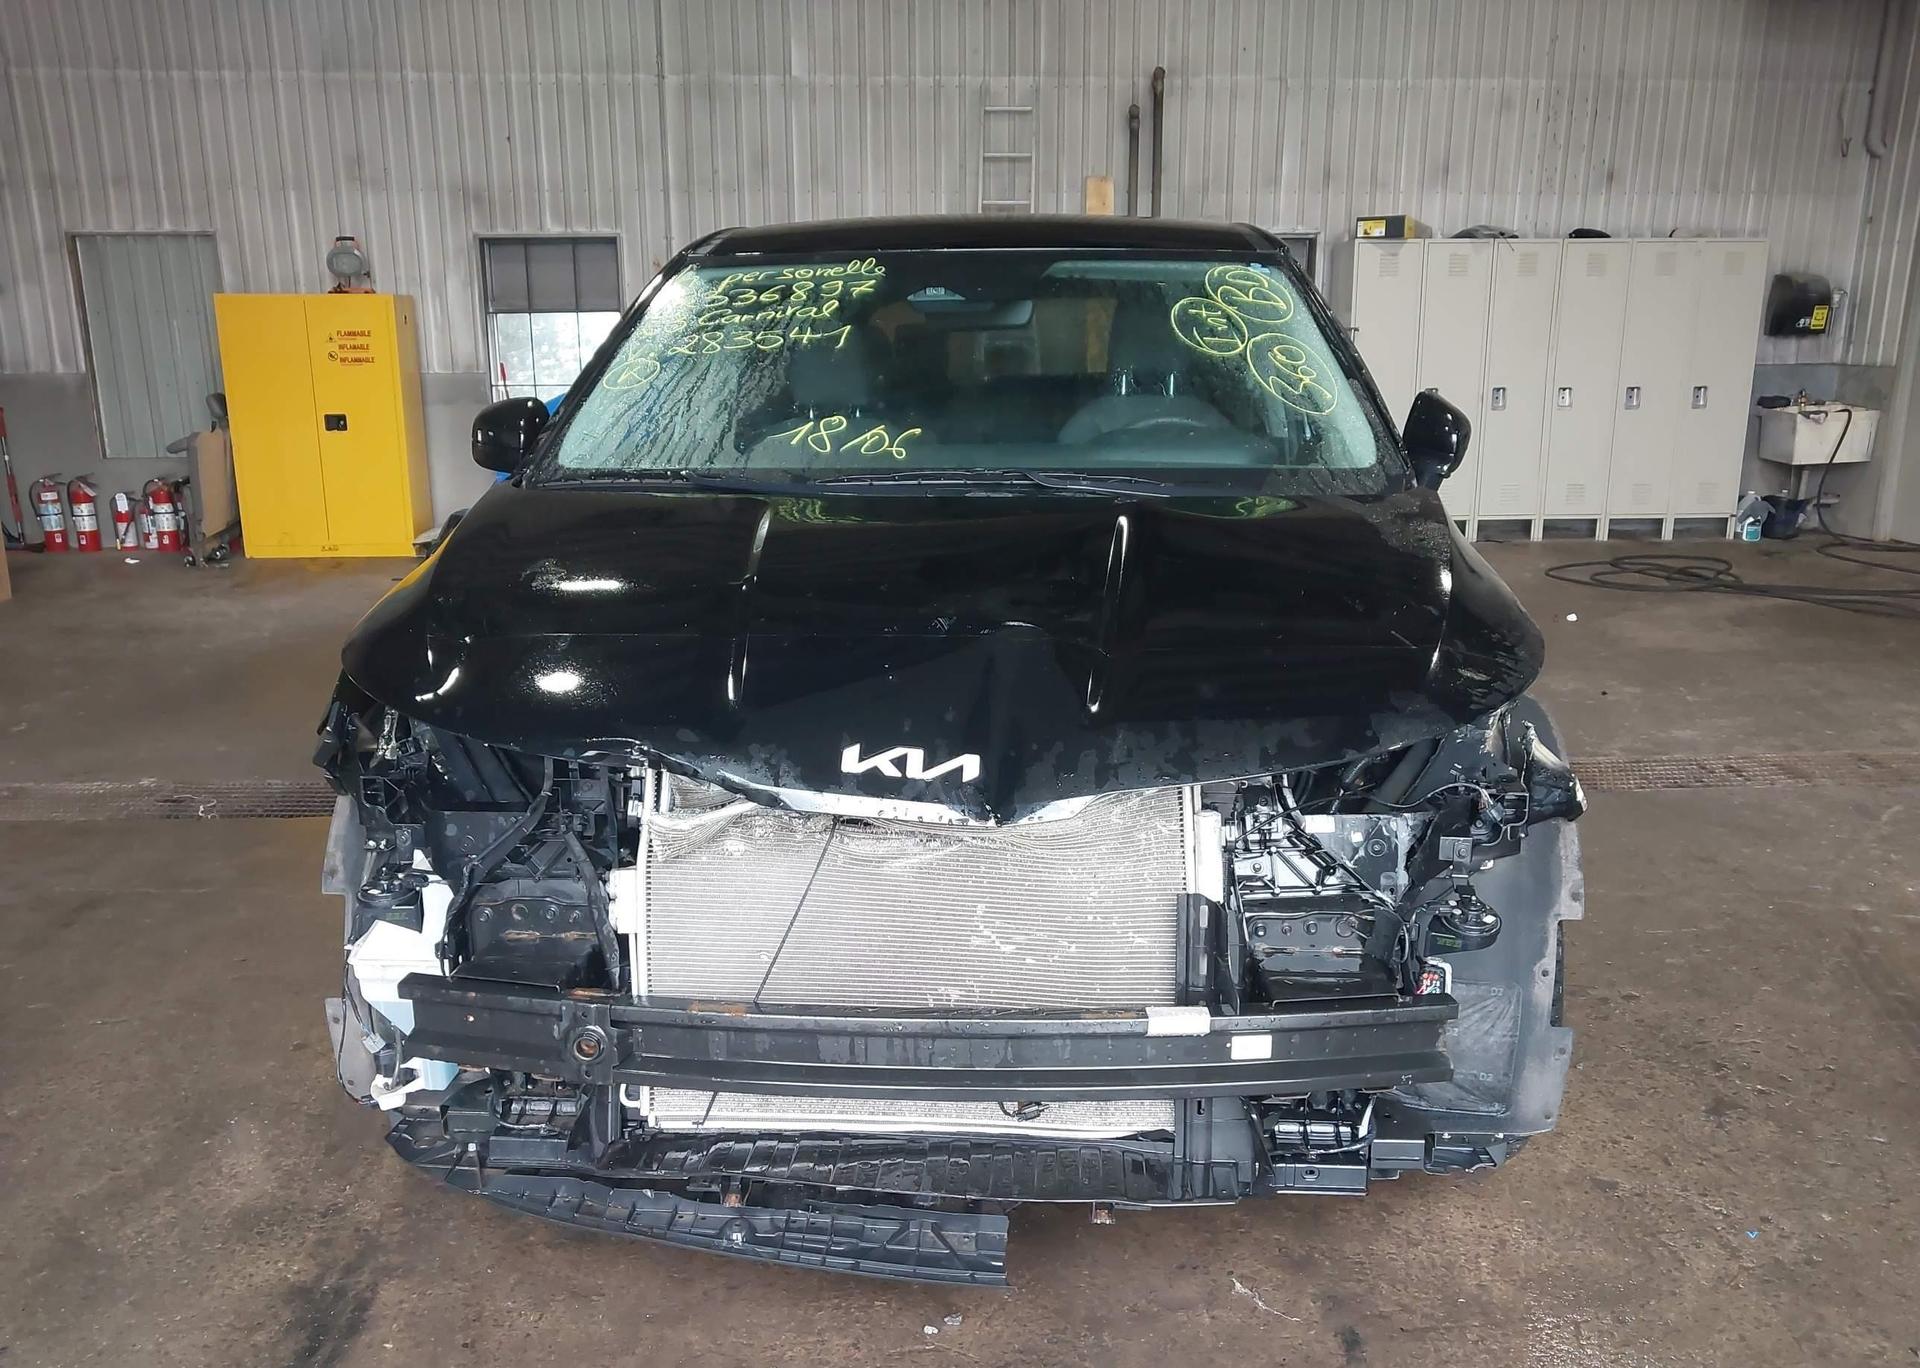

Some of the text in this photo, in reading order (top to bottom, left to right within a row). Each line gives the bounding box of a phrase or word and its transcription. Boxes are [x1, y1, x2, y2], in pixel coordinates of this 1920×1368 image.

[336, 329, 372, 337] FLAMMABLE
[668, 324, 852, 355] 283541
[841, 743, 981, 783] KIA
